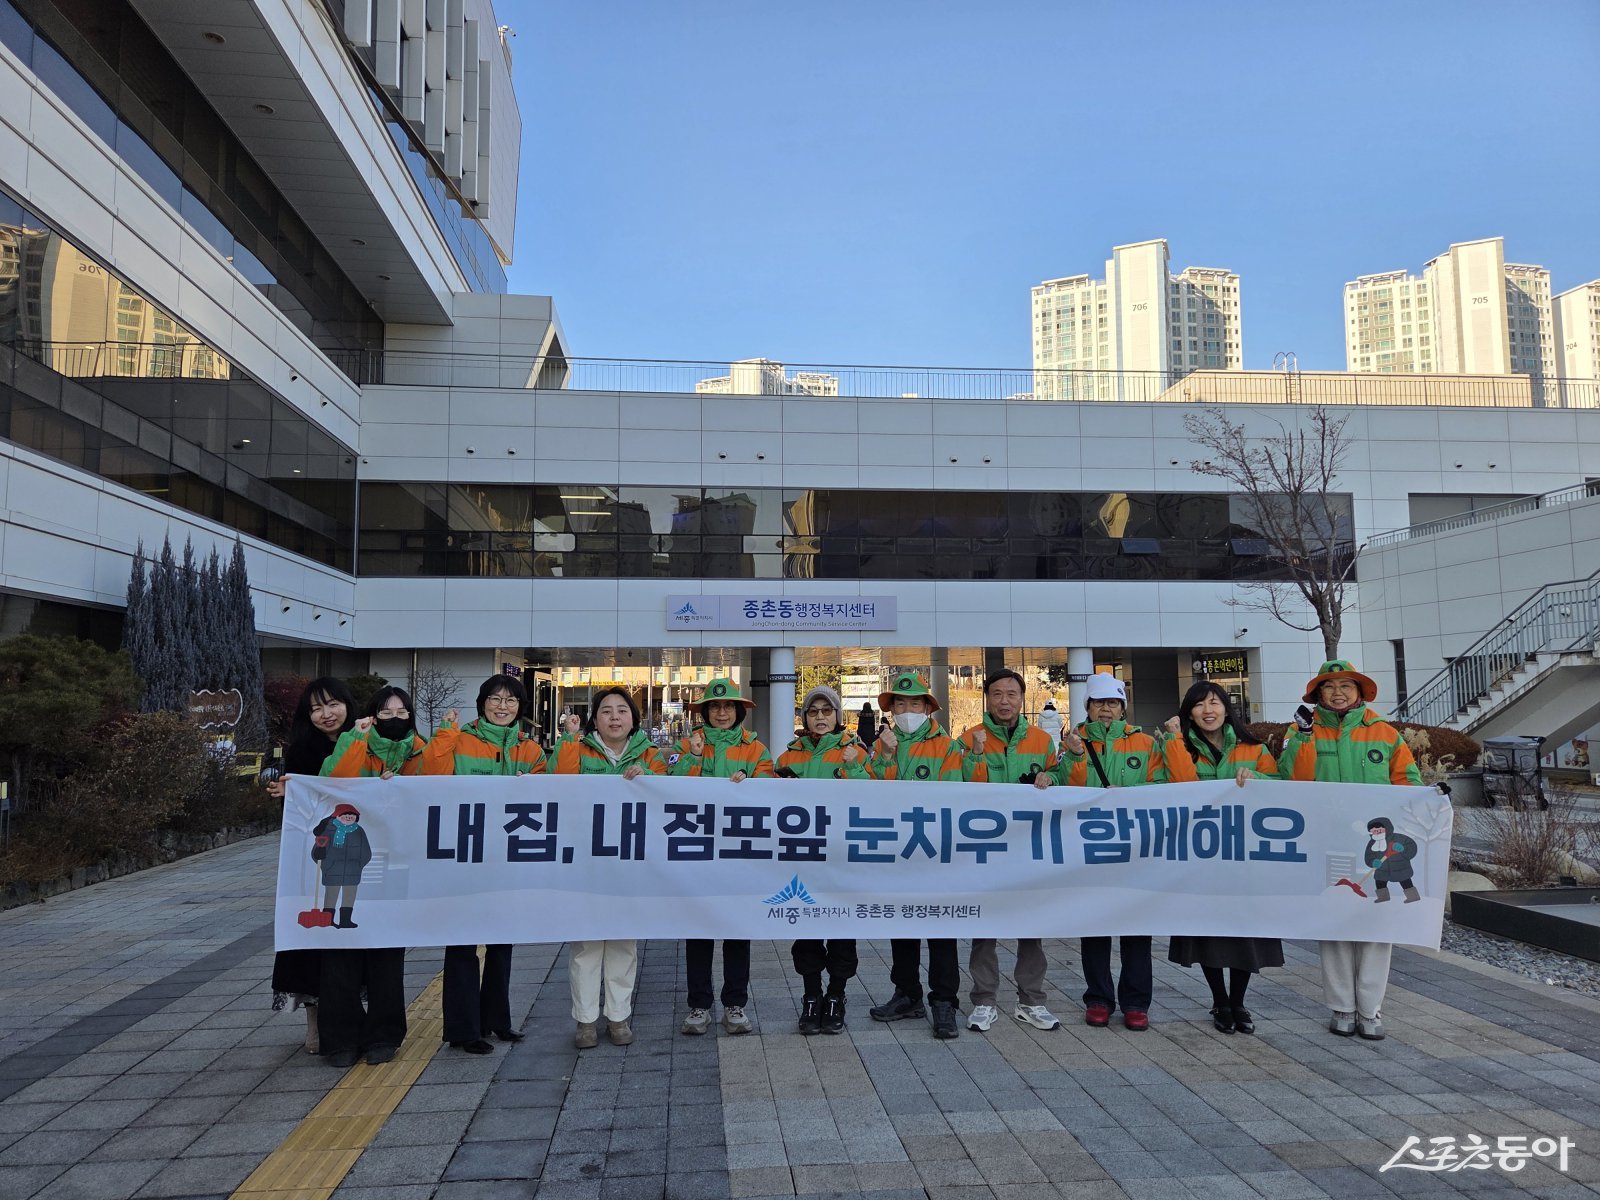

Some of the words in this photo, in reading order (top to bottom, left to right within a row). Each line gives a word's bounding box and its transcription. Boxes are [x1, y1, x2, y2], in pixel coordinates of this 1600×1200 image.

[1471, 296, 1489, 305] 705
[1131, 302, 1148, 312] 706
[1565, 341, 1578, 351] 704
[795, 620, 827, 628] Community
[1207, 657, 1244, 673] 종촌어린이집
[427, 804, 485, 863] 내
[503, 802, 574, 863] 집,
[592, 803, 647, 861] 내
[663, 803, 832, 863] 점포앞
[845, 805, 1064, 865] 눈치우기
[1077, 805, 1308, 864] 함께해요
[855, 904, 896, 919] 종촌동
[901, 904, 981, 918] 행정복지센터
